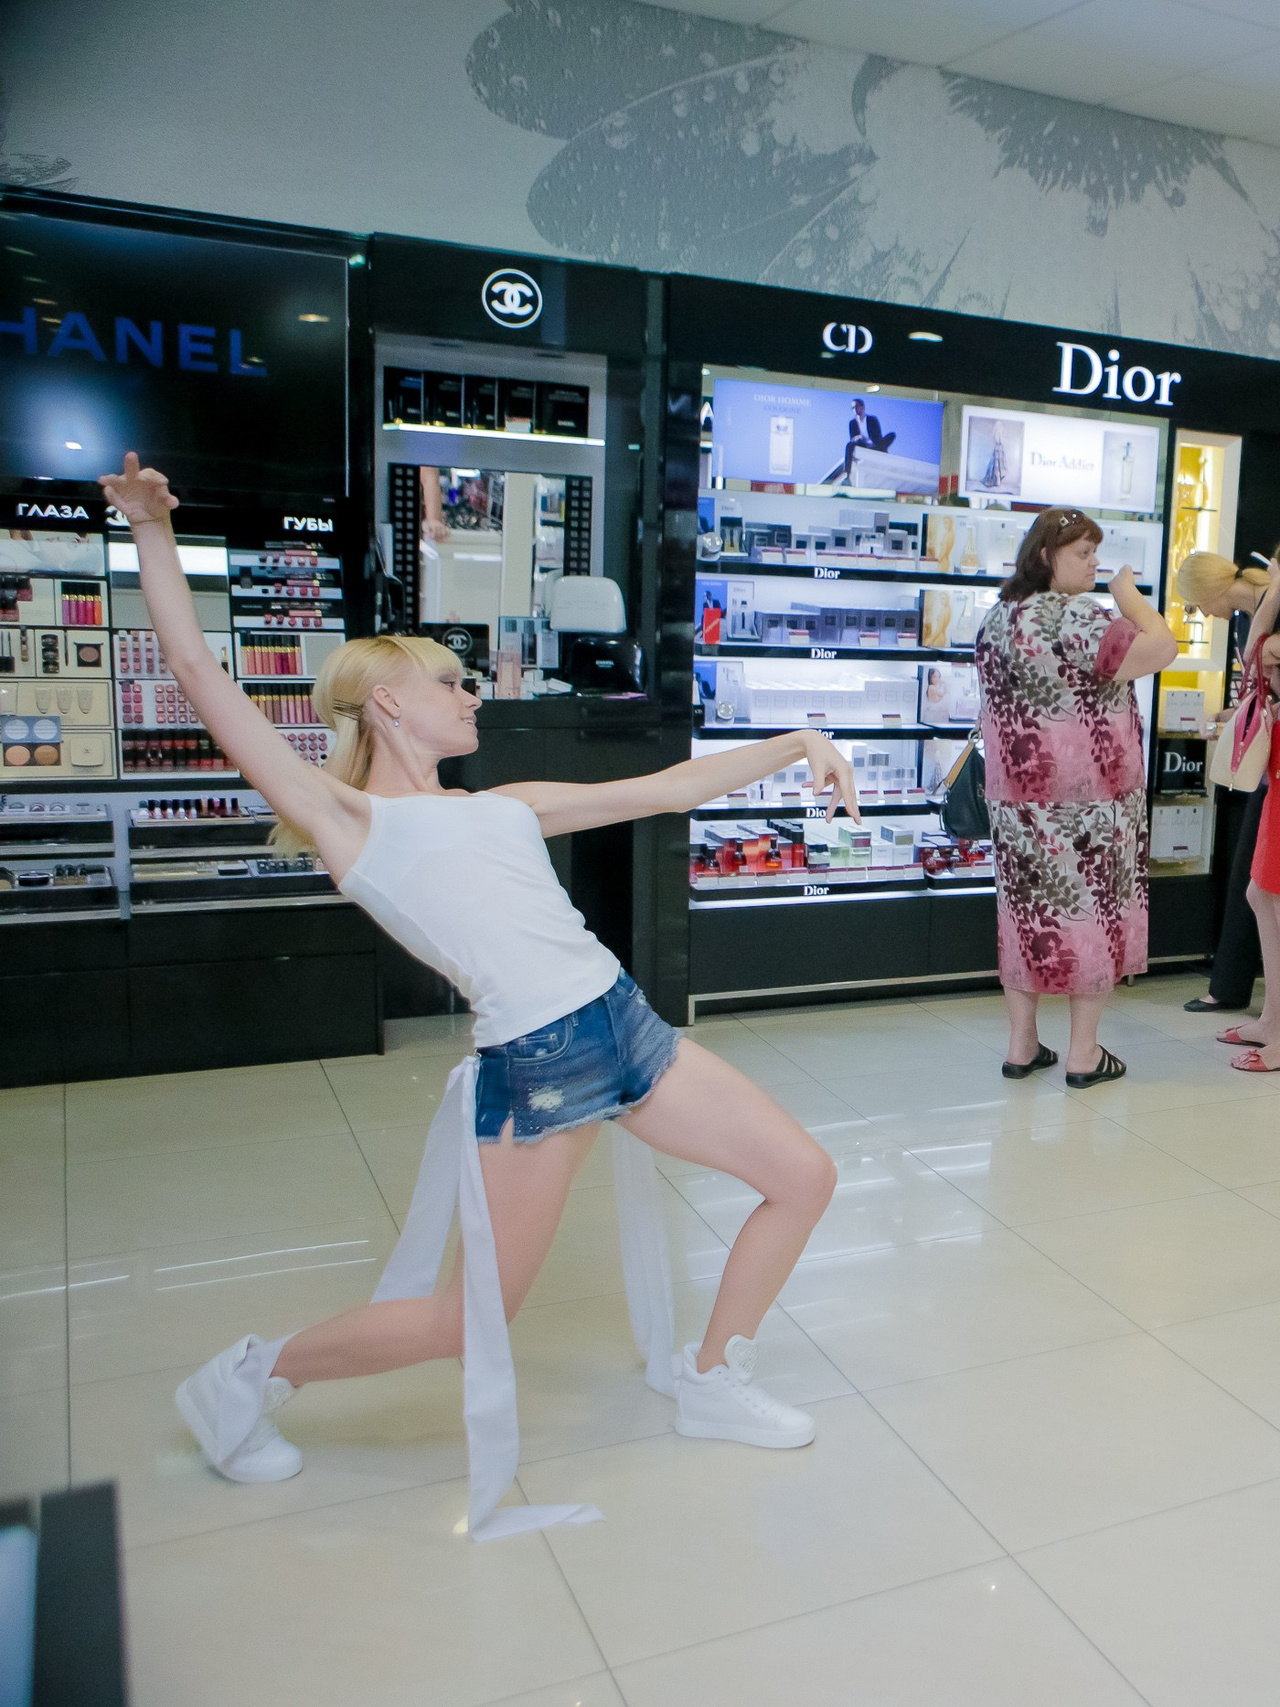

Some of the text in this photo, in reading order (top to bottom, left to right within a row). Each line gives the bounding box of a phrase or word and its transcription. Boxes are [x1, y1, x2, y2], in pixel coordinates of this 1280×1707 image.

[1052, 341, 1182, 406] Dior
[753, 393, 812, 407] DIOR HOMME
[1031, 451, 1095, 471] Dior Addict
[16, 502, 90, 519] ГЛАЗА
[283, 516, 334, 532] ГУБЫ
[814, 566, 841, 580] Dior
[811, 646, 838, 659] Dior
[1163, 751, 1204, 772] Dior
[806, 806, 827, 818] Dio
[803, 885, 830, 897] Dior
